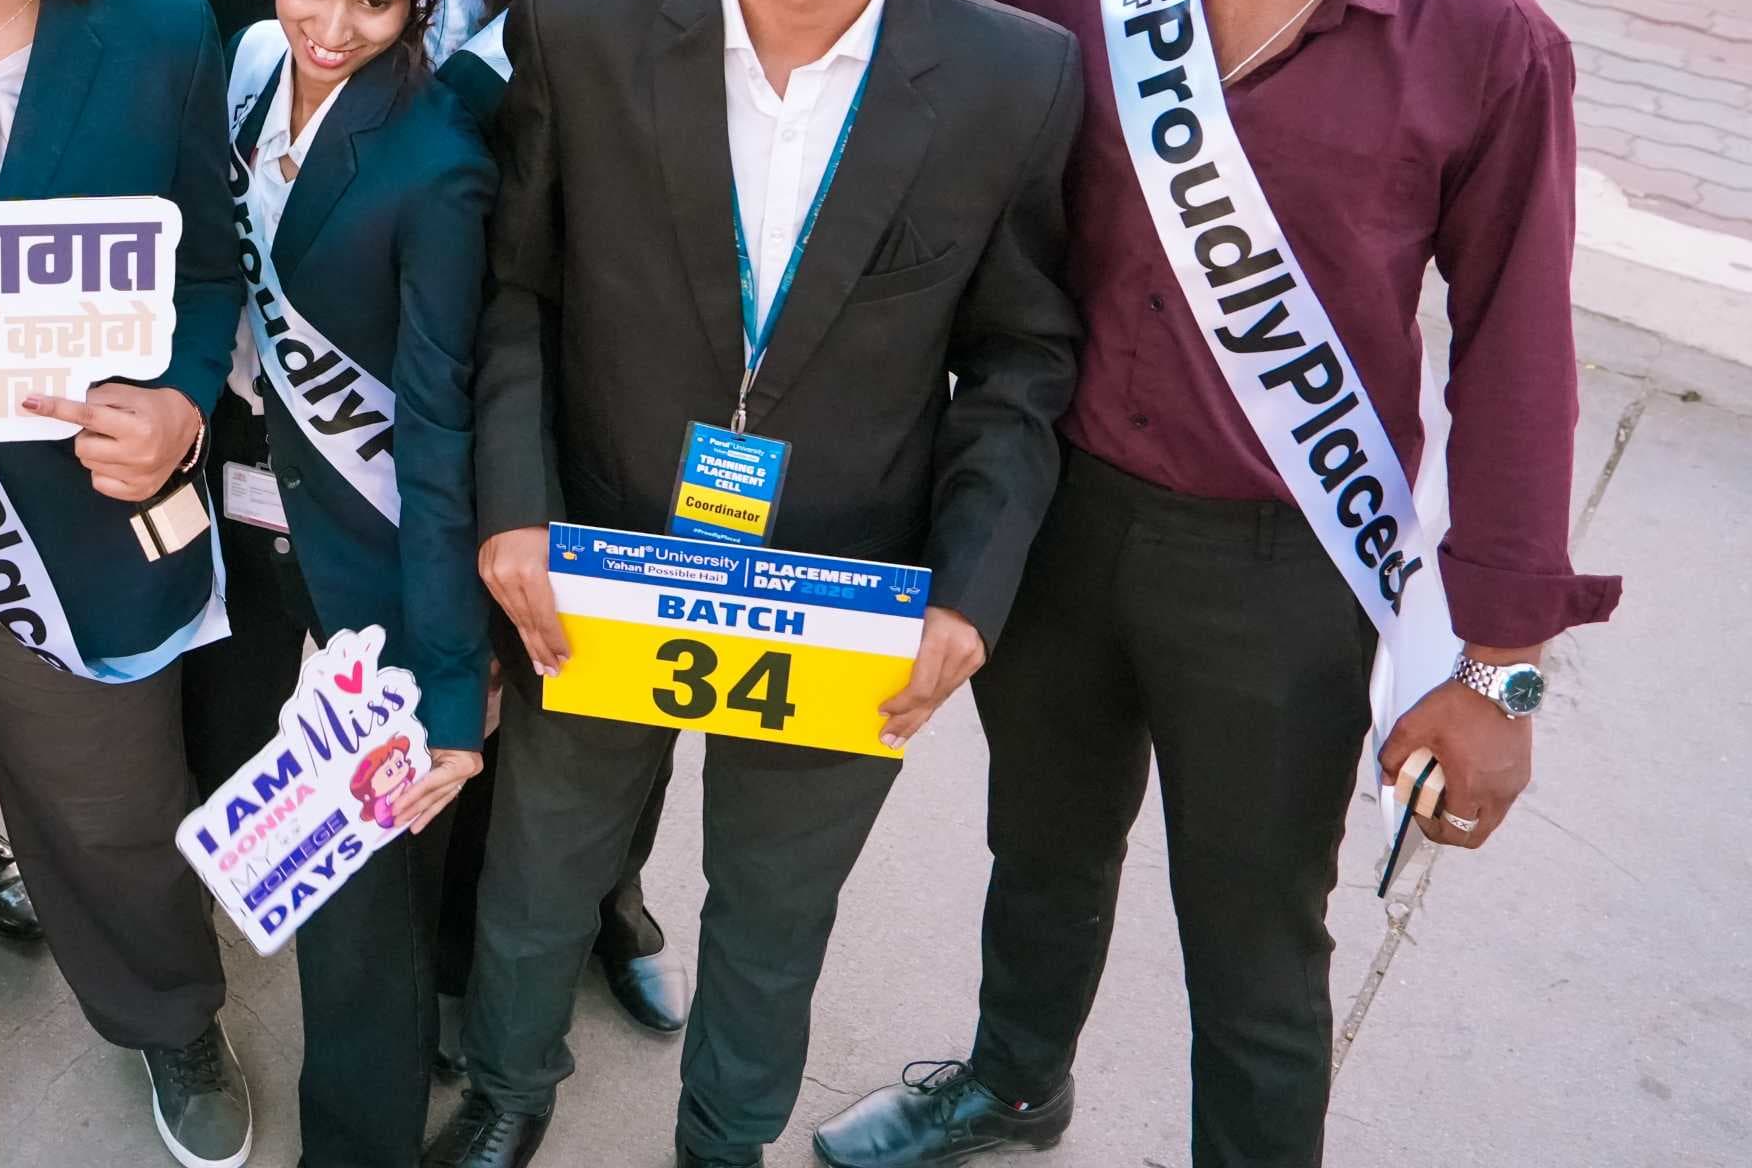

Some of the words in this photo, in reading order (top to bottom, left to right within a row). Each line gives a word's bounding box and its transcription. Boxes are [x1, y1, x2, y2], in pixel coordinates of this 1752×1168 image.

[3, 299, 158, 359] करोगे
[696, 465, 766, 488] PLACEMENT
[699, 454, 754, 475] TRAINING
[756, 467, 766, 478] &
[714, 479, 741, 493] CELL
[685, 495, 761, 523] Coordinator
[606, 559, 643, 573] Yahan
[648, 565, 696, 580] Possible
[655, 547, 740, 572] University
[753, 575, 796, 592] DAY
[800, 581, 856, 600] 2026
[754, 560, 882, 588] PLACEMENT
[657, 593, 806, 637] BATCH
[651, 637, 796, 731] 34
[297, 685, 405, 778] Miss
[197, 826, 219, 855] I
[225, 749, 304, 837] AM
[218, 783, 317, 873] GONNA
[259, 833, 363, 936] DAYS
